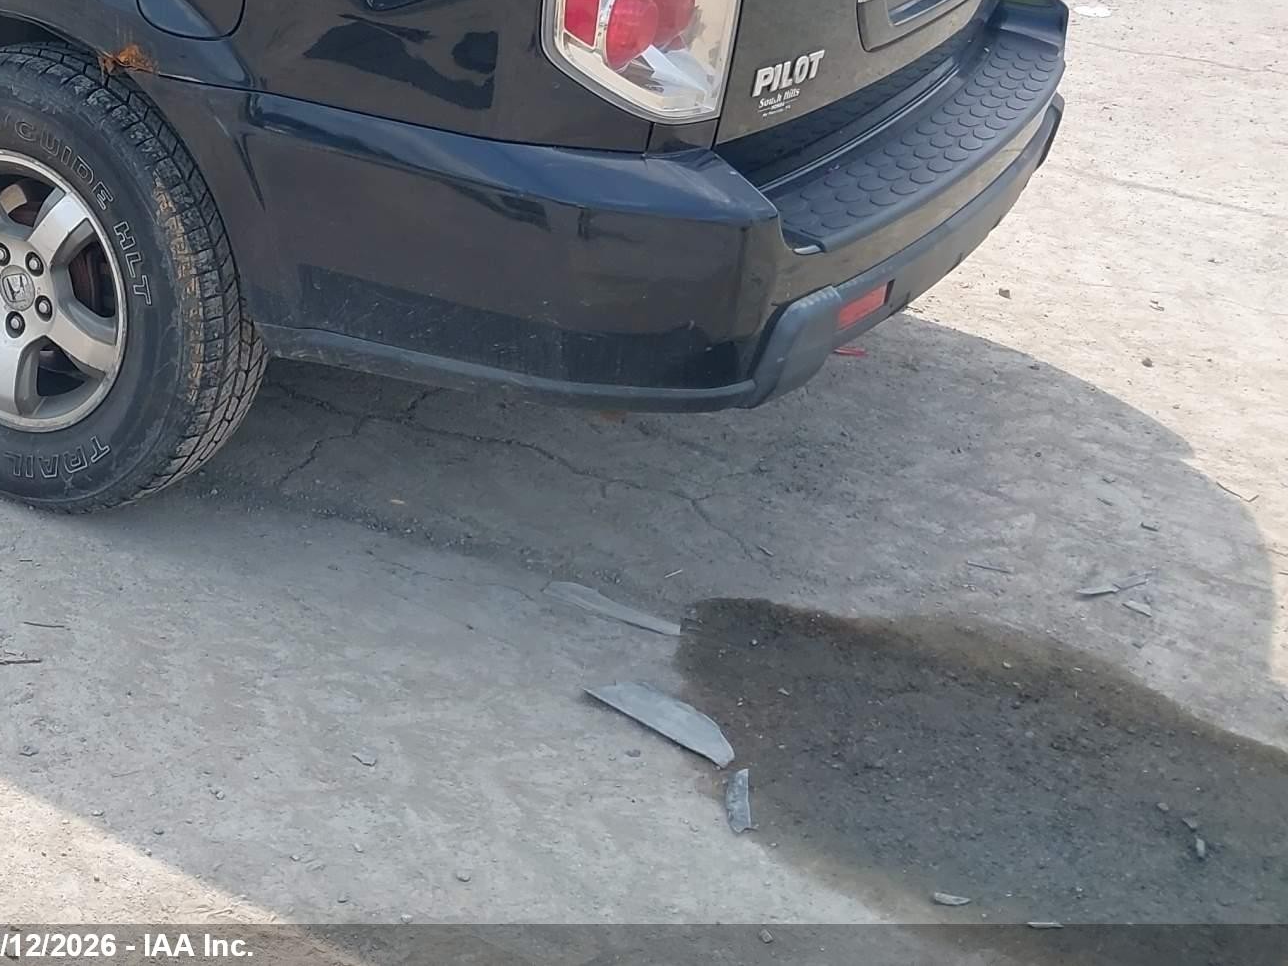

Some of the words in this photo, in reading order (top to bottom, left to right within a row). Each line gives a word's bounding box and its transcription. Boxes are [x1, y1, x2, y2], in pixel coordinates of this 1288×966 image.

[751, 49, 825, 97] PILOT
[14, 120, 114, 211] GUIDE
[113, 220, 153, 306] HLT
[3, 434, 111, 479] TRAIL
